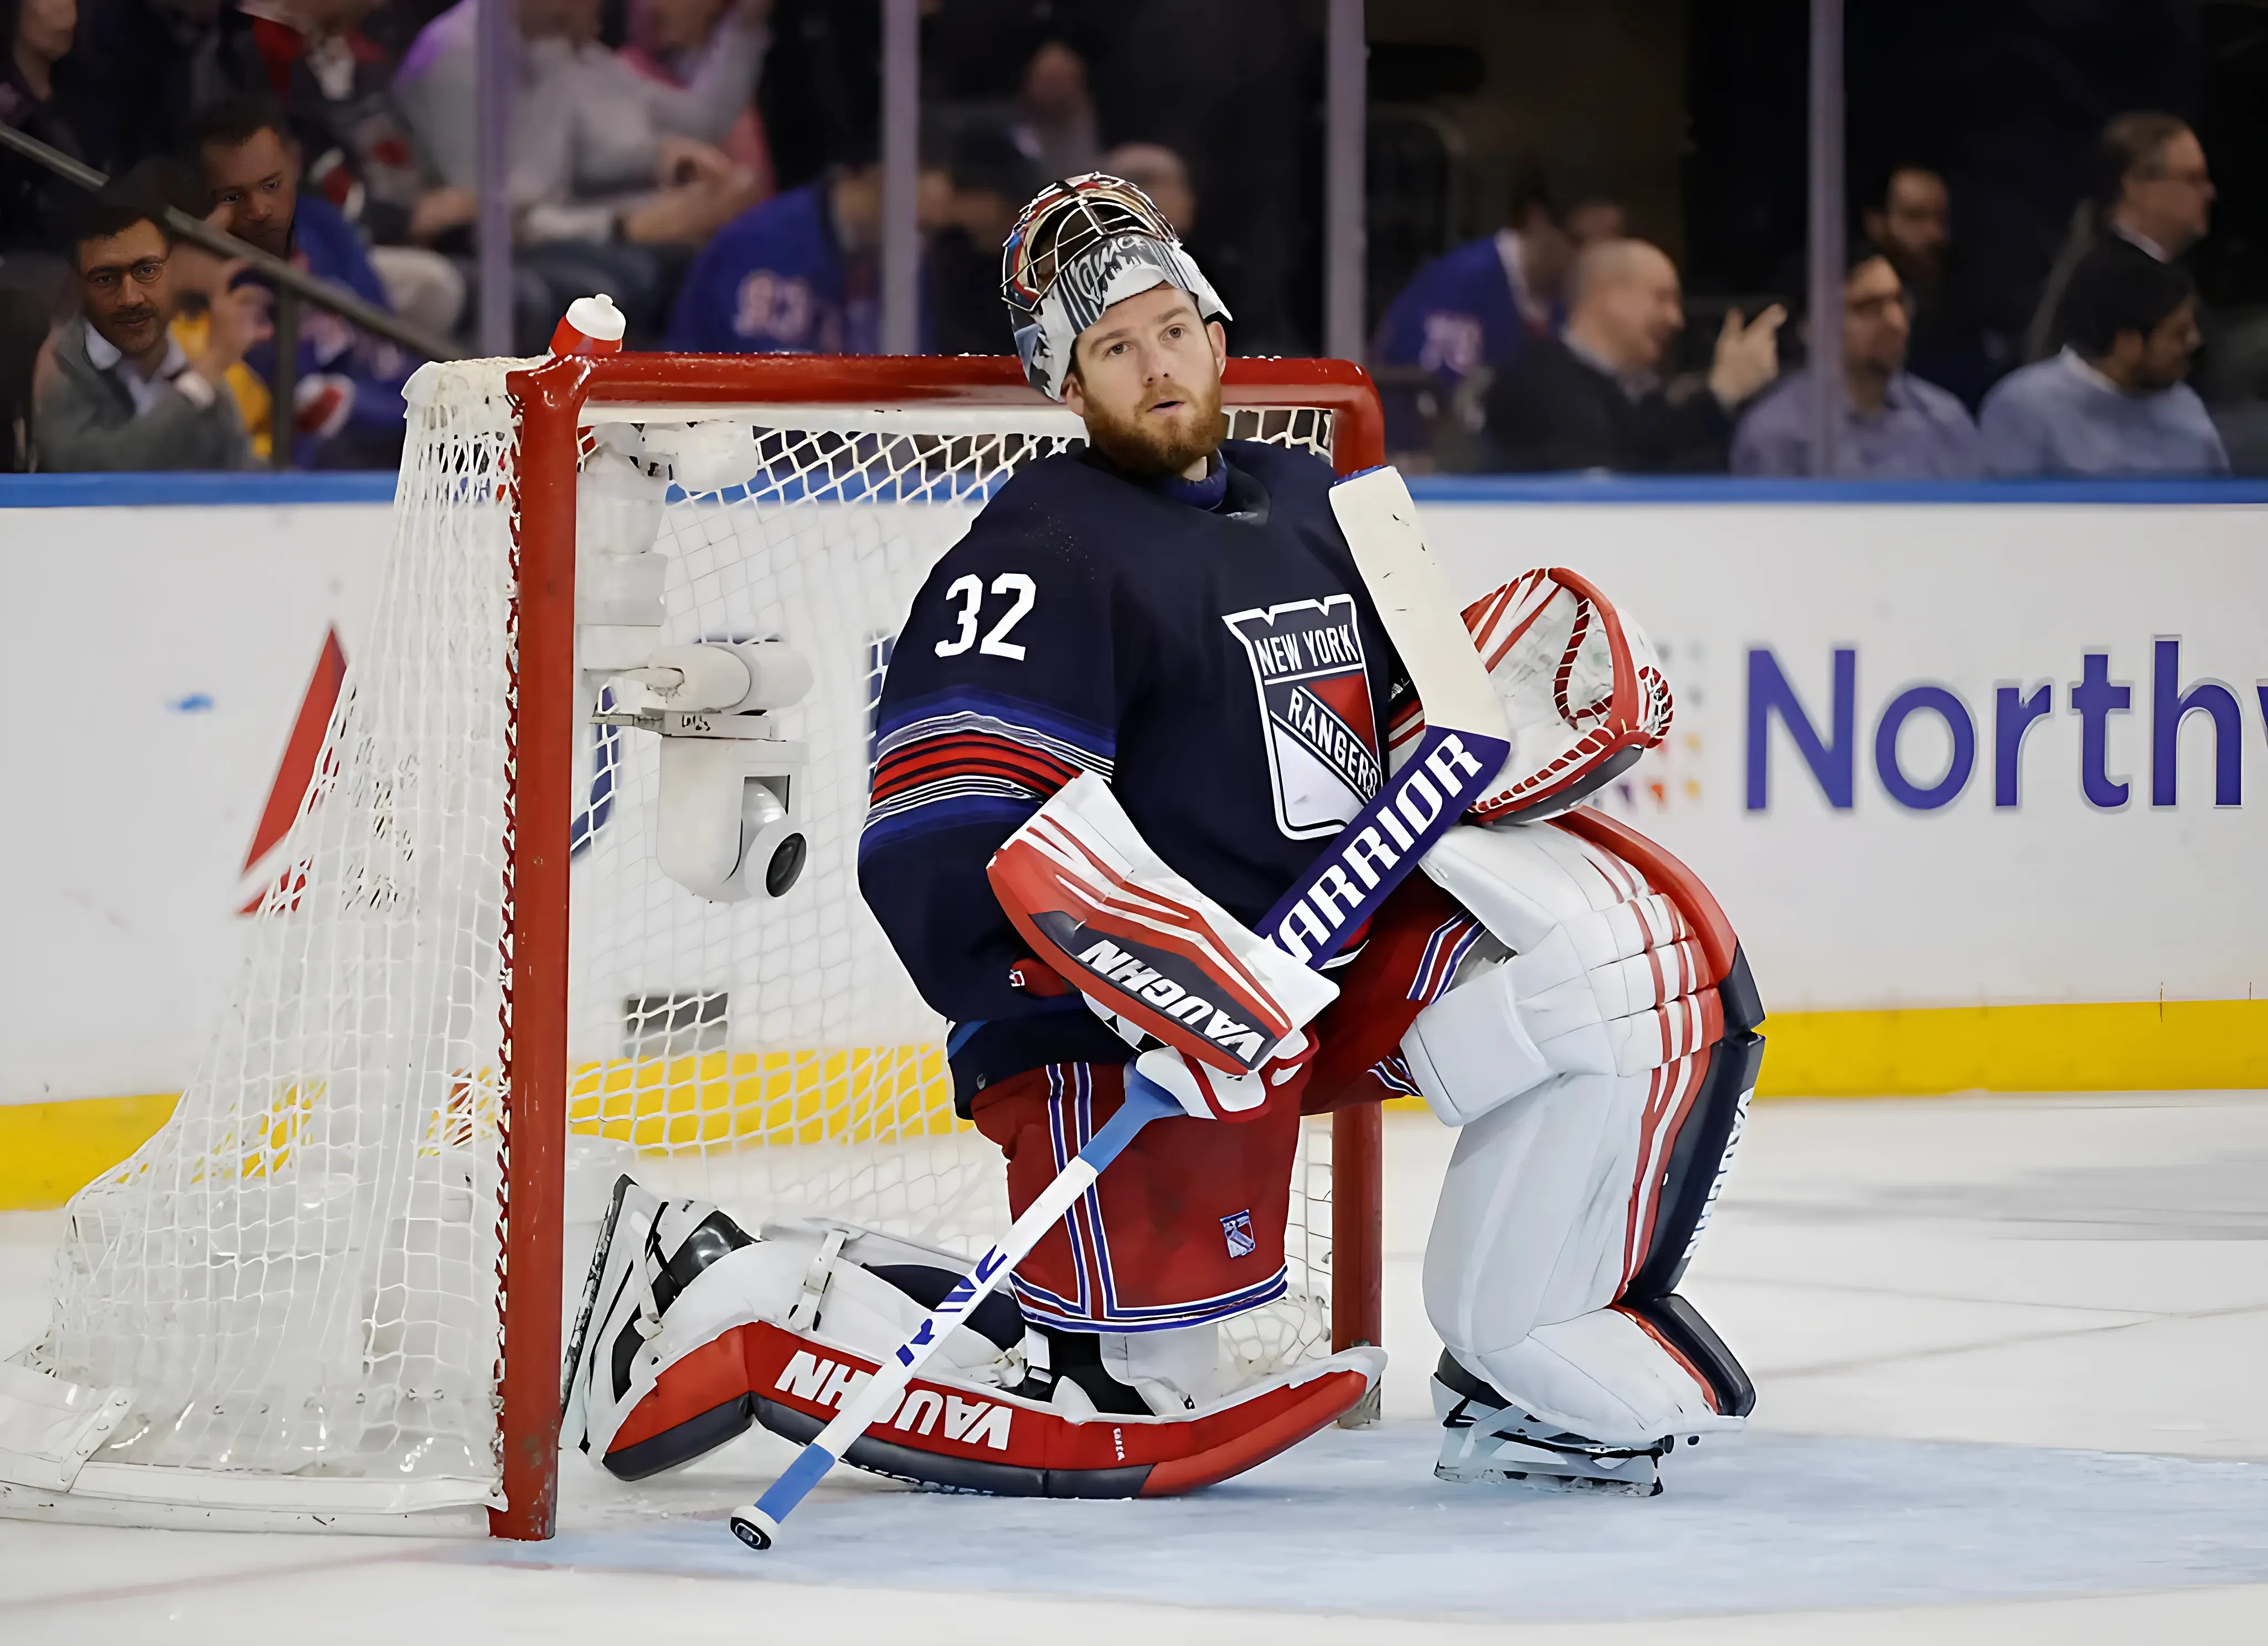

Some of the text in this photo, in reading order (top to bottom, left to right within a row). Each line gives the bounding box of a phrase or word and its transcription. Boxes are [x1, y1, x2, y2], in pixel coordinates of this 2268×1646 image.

[935, 573, 1036, 661] 32
[1255, 624, 1358, 676] NEW YORK
[1747, 640, 2268, 809] North
[1269, 733, 1483, 965] ARRIOR
[1077, 939, 1265, 1063] VAUGHN
